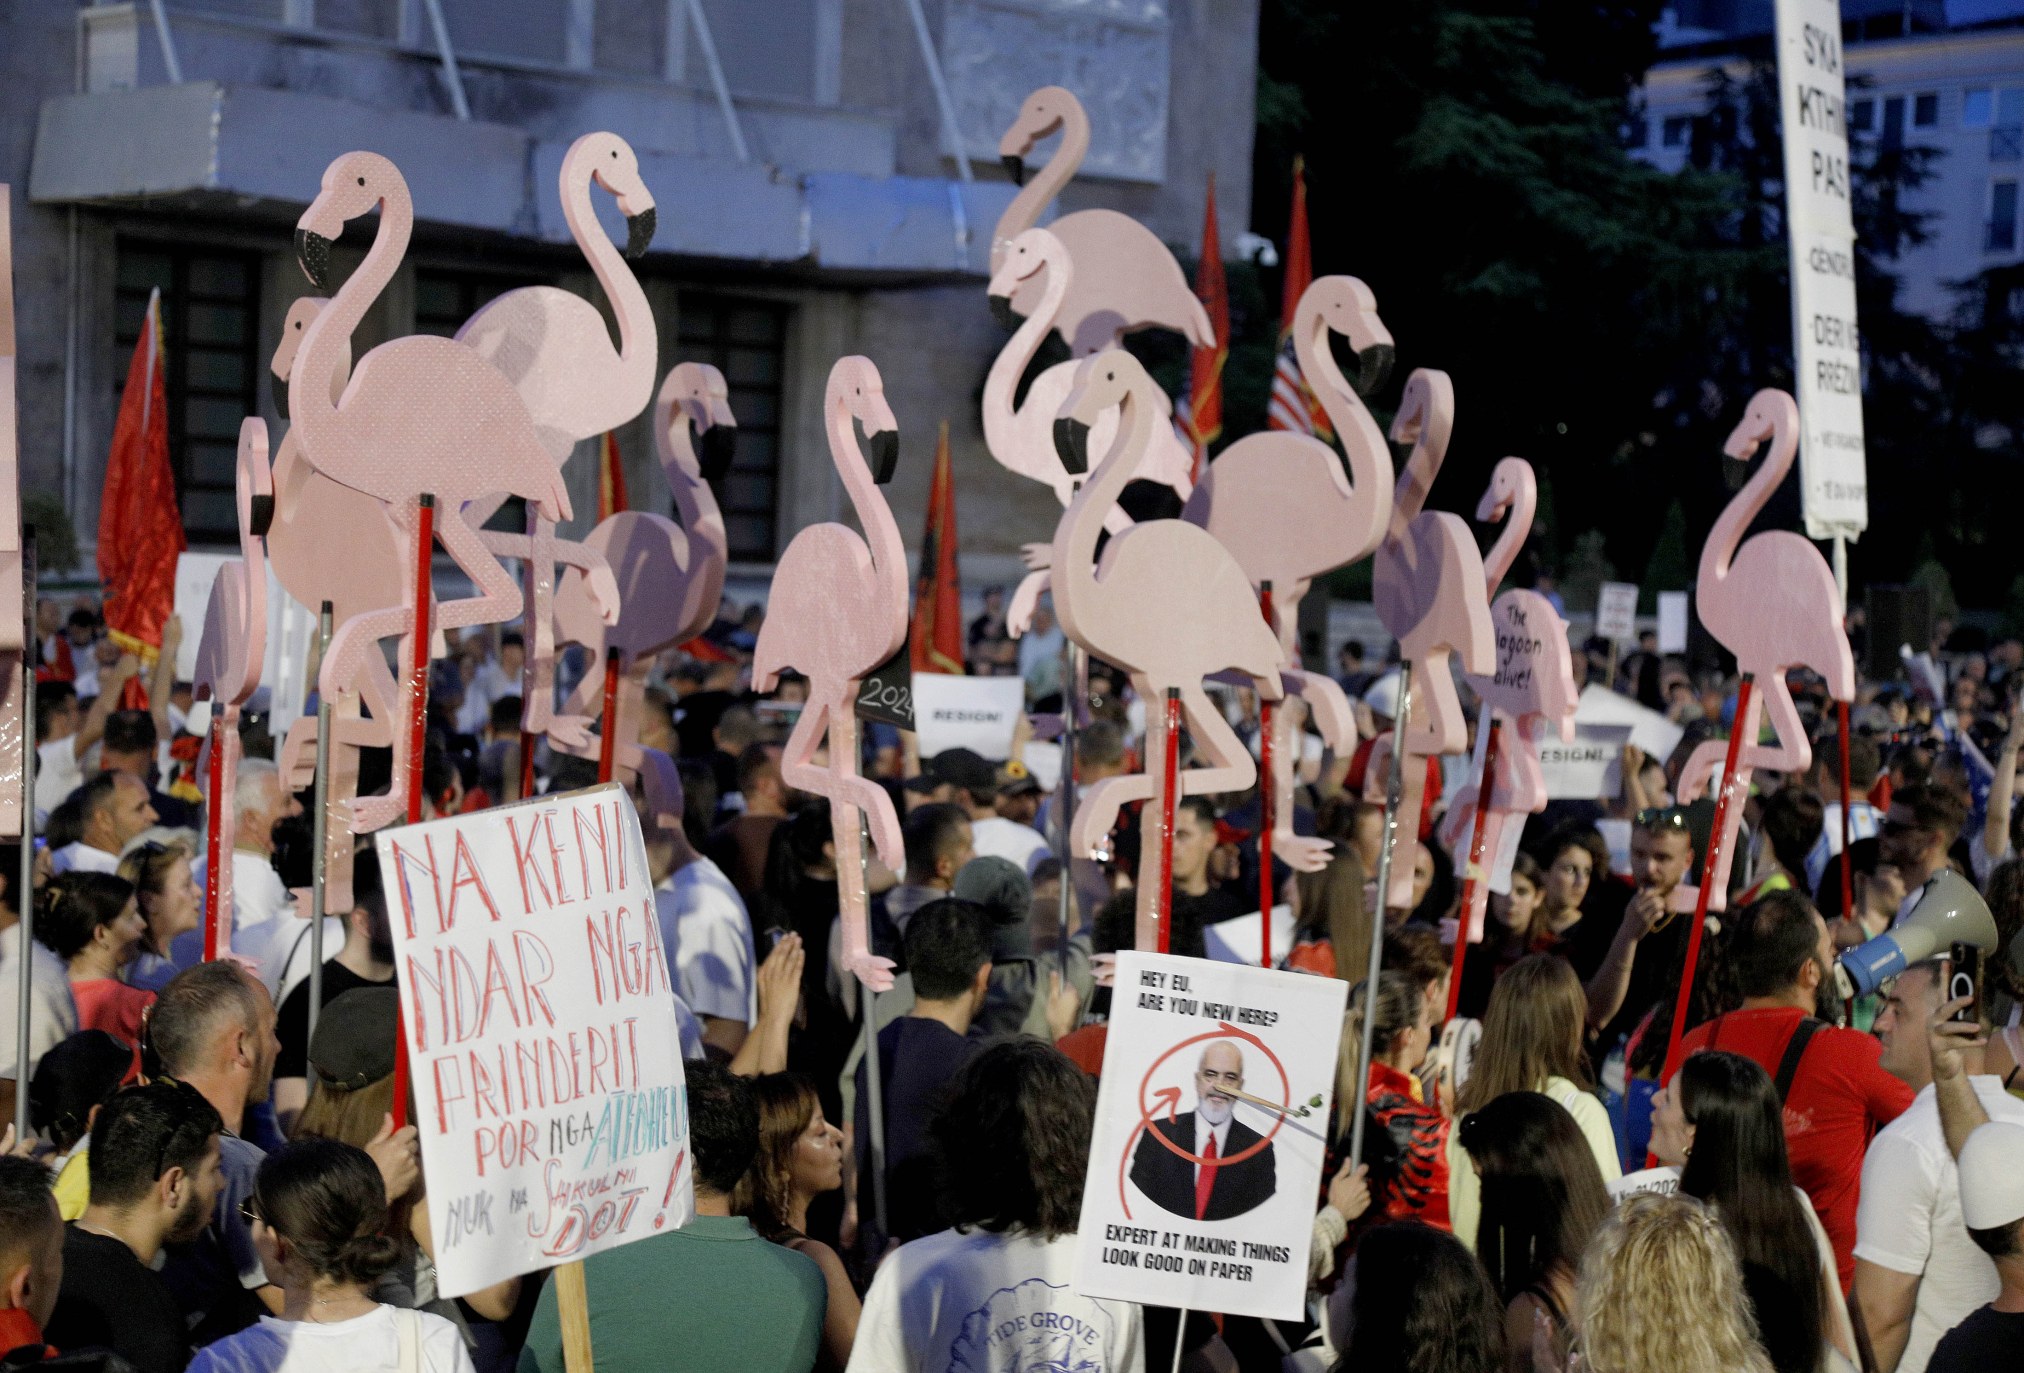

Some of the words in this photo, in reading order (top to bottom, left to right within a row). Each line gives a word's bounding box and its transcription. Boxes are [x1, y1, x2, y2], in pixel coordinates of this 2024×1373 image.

[1506, 604, 1527, 627] The
[1497, 630, 1542, 665] lagoon
[1494, 667, 1532, 690] alive!
[933, 709, 1003, 722] RESIGN!
[1541, 750, 1604, 763] ESIGN!
[392, 829, 500, 940] NA
[505, 800, 631, 915] KENI
[406, 930, 557, 1053] NDAR
[586, 898, 672, 1006] NGA
[1140, 970, 1167, 988] HEY
[1171, 974, 1193, 994] EU,
[1137, 992, 1164, 1011] ARE
[1169, 996, 1199, 1016] YOU
[1202, 1001, 1235, 1021] NEW
[1237, 1006, 1279, 1027] HERE?
[432, 1017, 641, 1135] PRINDERIT
[475, 1120, 541, 1177] POR
[549, 1110, 594, 1157] NGA
[442, 1188, 494, 1254] NUK
[1105, 1224, 1158, 1246] EXPERT
[1161, 1231, 1180, 1249] AT
[1184, 1234, 1238, 1256] MAKING
[1241, 1241, 1290, 1264] THINGS
[1102, 1247, 1140, 1267] LOOK
[1144, 1253, 1184, 1273] GOOD
[1188, 1258, 1207, 1276] ON
[1210, 1261, 1254, 1282] PAPER
[985, 1315, 1028, 1349] TIDE
[1030, 1312, 1100, 1346] GROVE
